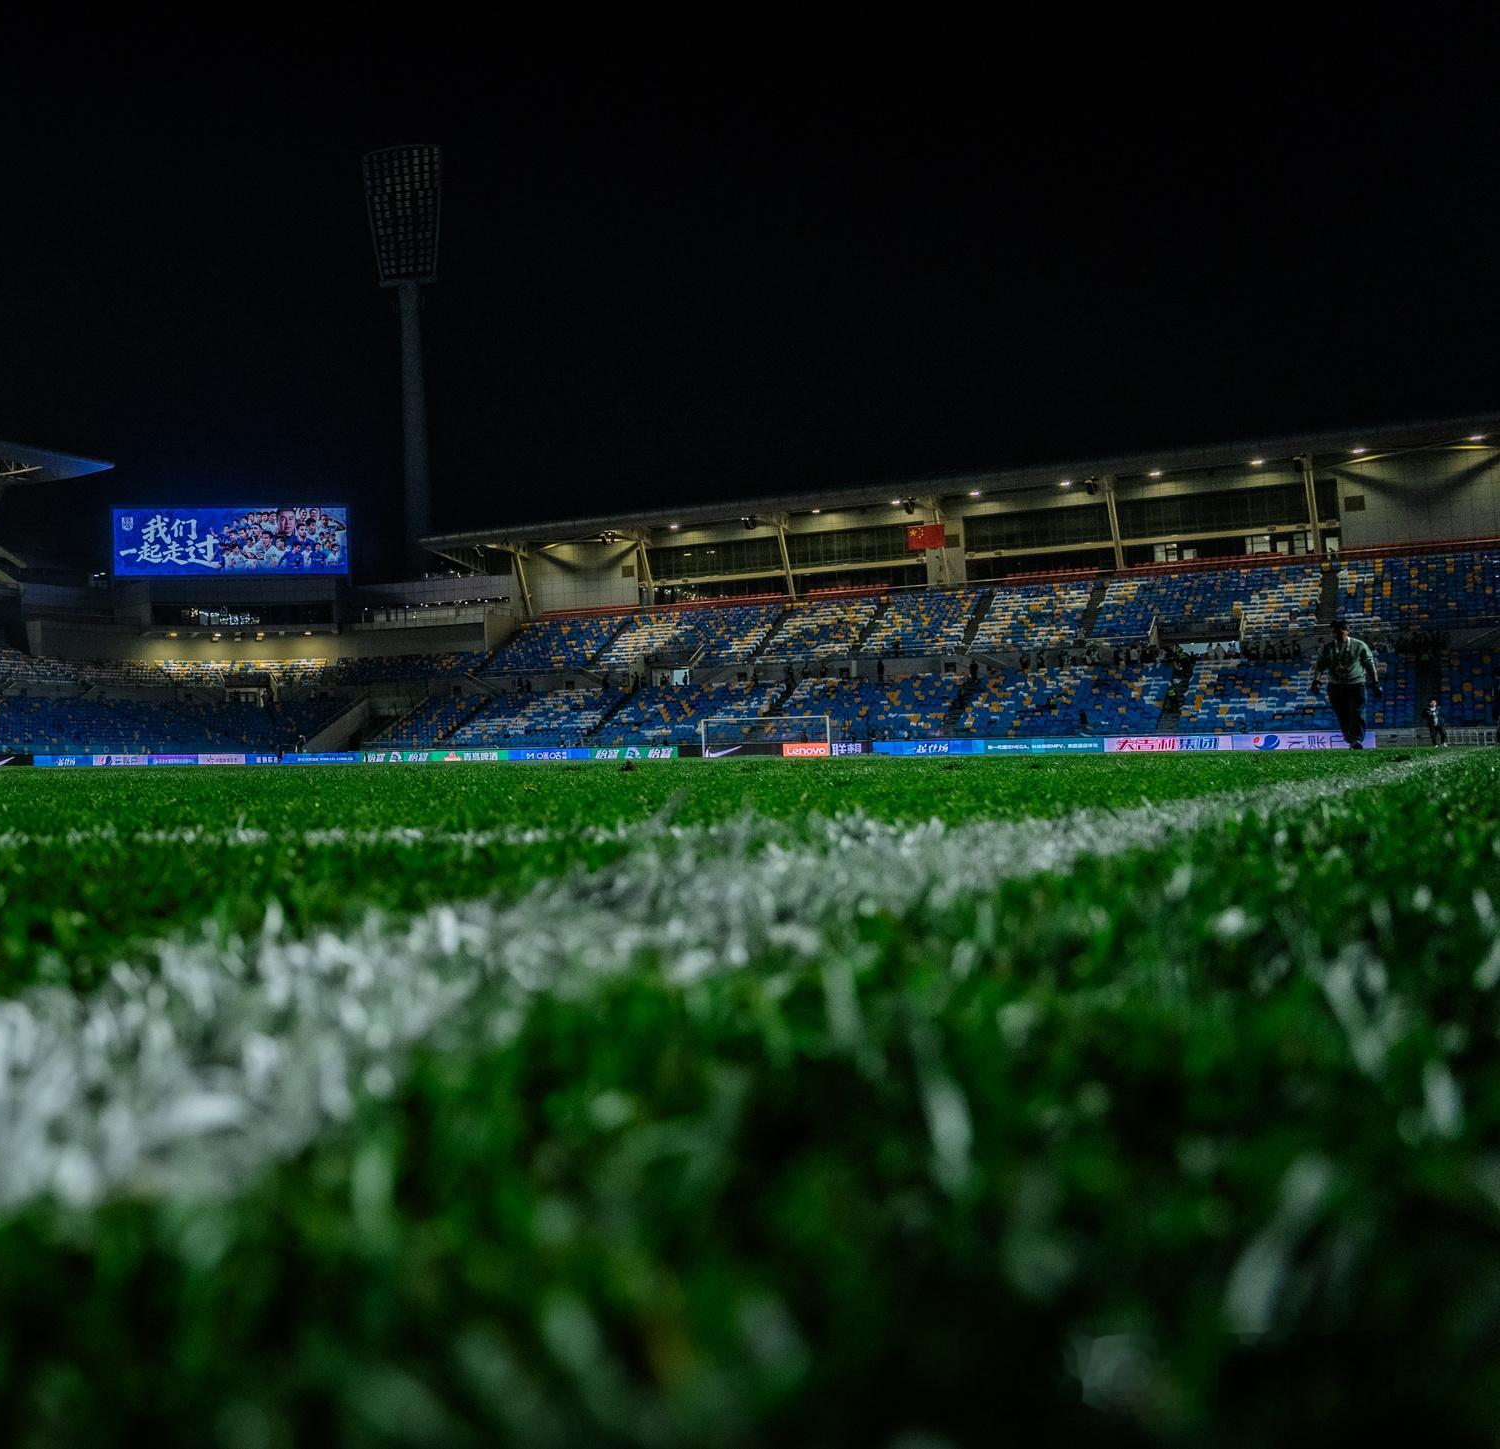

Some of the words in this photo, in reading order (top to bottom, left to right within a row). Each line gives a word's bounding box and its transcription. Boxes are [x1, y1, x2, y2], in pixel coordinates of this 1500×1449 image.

[141, 515, 198, 543] 我们
[120, 535, 221, 569] 一起走过
[1117, 737, 1219, 751] 大吉利集团
[1287, 735, 1345, 749] 云账户
[787, 746, 826, 755] Lenovo
